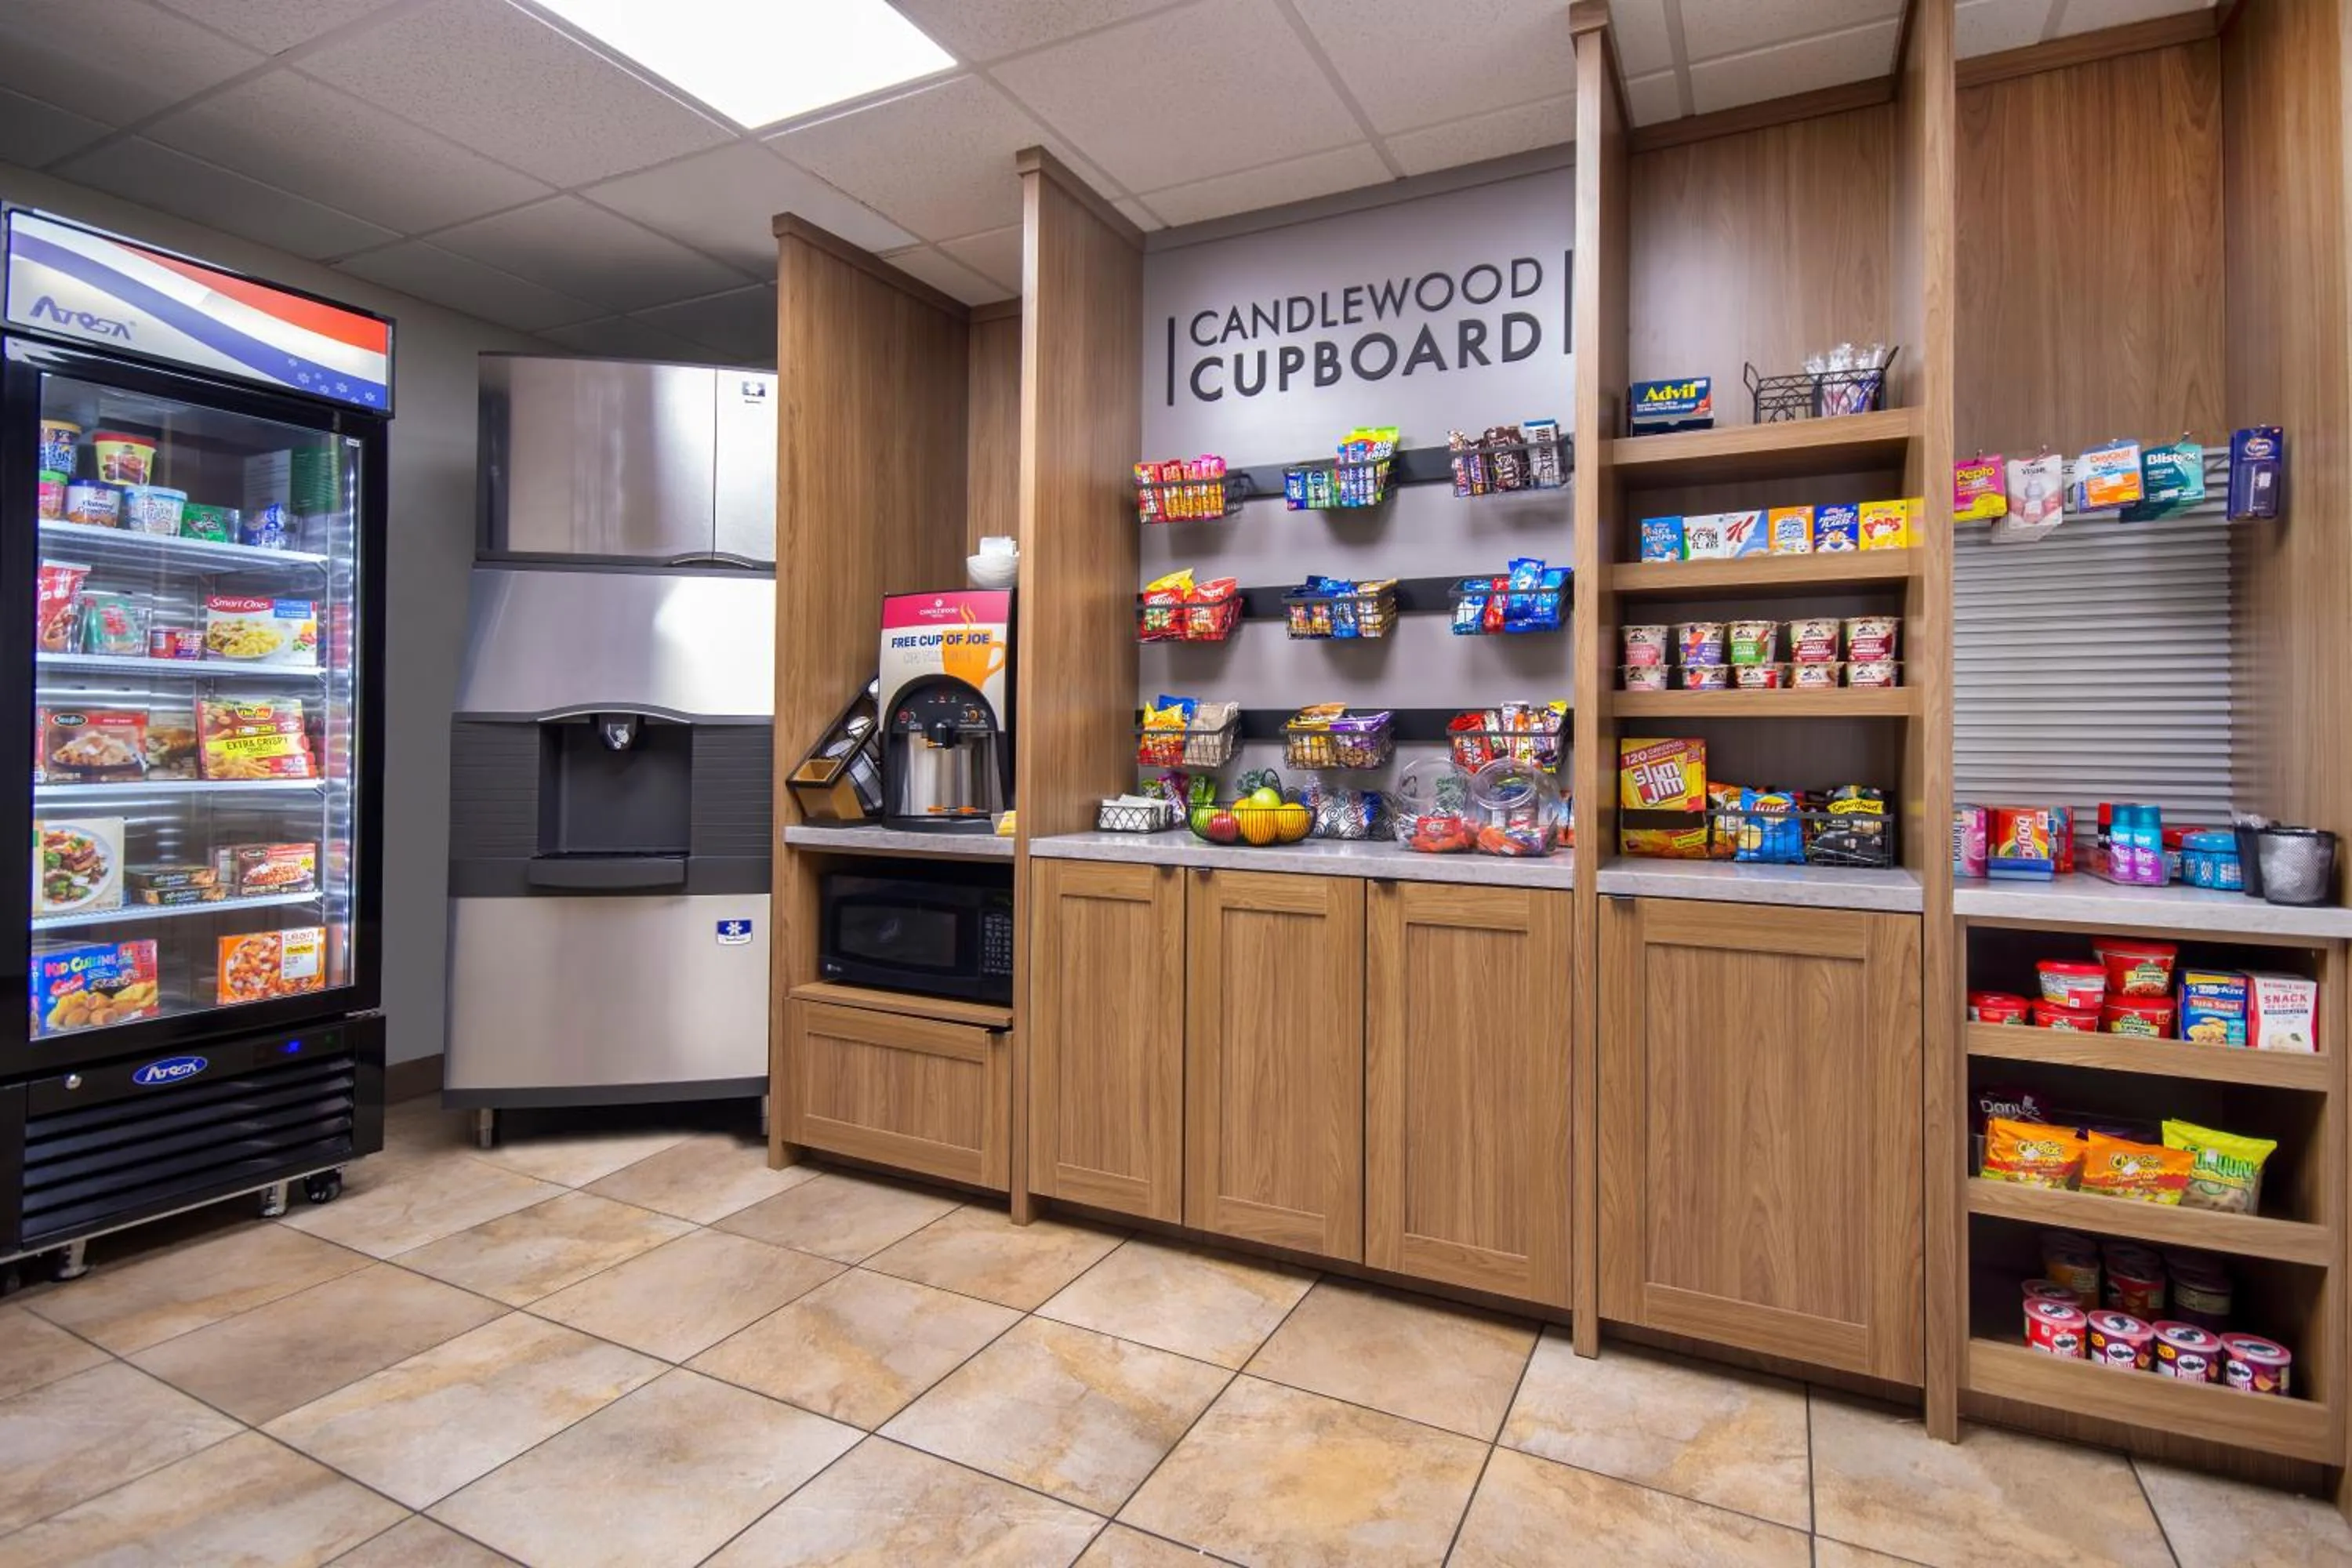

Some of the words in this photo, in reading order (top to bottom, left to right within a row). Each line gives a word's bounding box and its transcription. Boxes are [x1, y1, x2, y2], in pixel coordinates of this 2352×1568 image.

[1189, 256, 1544, 347] CANDLEWOOD
[1189, 312, 1542, 402] CUPBOARD
[1643, 383, 1697, 402] Advil
[1956, 466, 1995, 481] Pepto
[209, 597, 241, 608] Smart
[243, 599, 269, 609] Ones
[891, 636, 916, 648] FREE
[919, 634, 944, 647] CUP
[946, 634, 964, 645] OF
[966, 633, 990, 644] JOE
[226, 740, 255, 751] EXTRA
[256, 736, 289, 746] CRISPY
[1624, 752, 1647, 765] 120
[2016, 815, 2037, 859] bounc
[2263, 993, 2308, 1004] SNACK
[1980, 1099, 2041, 1116] Doris
[2111, 1153, 2158, 1170] Chtos
